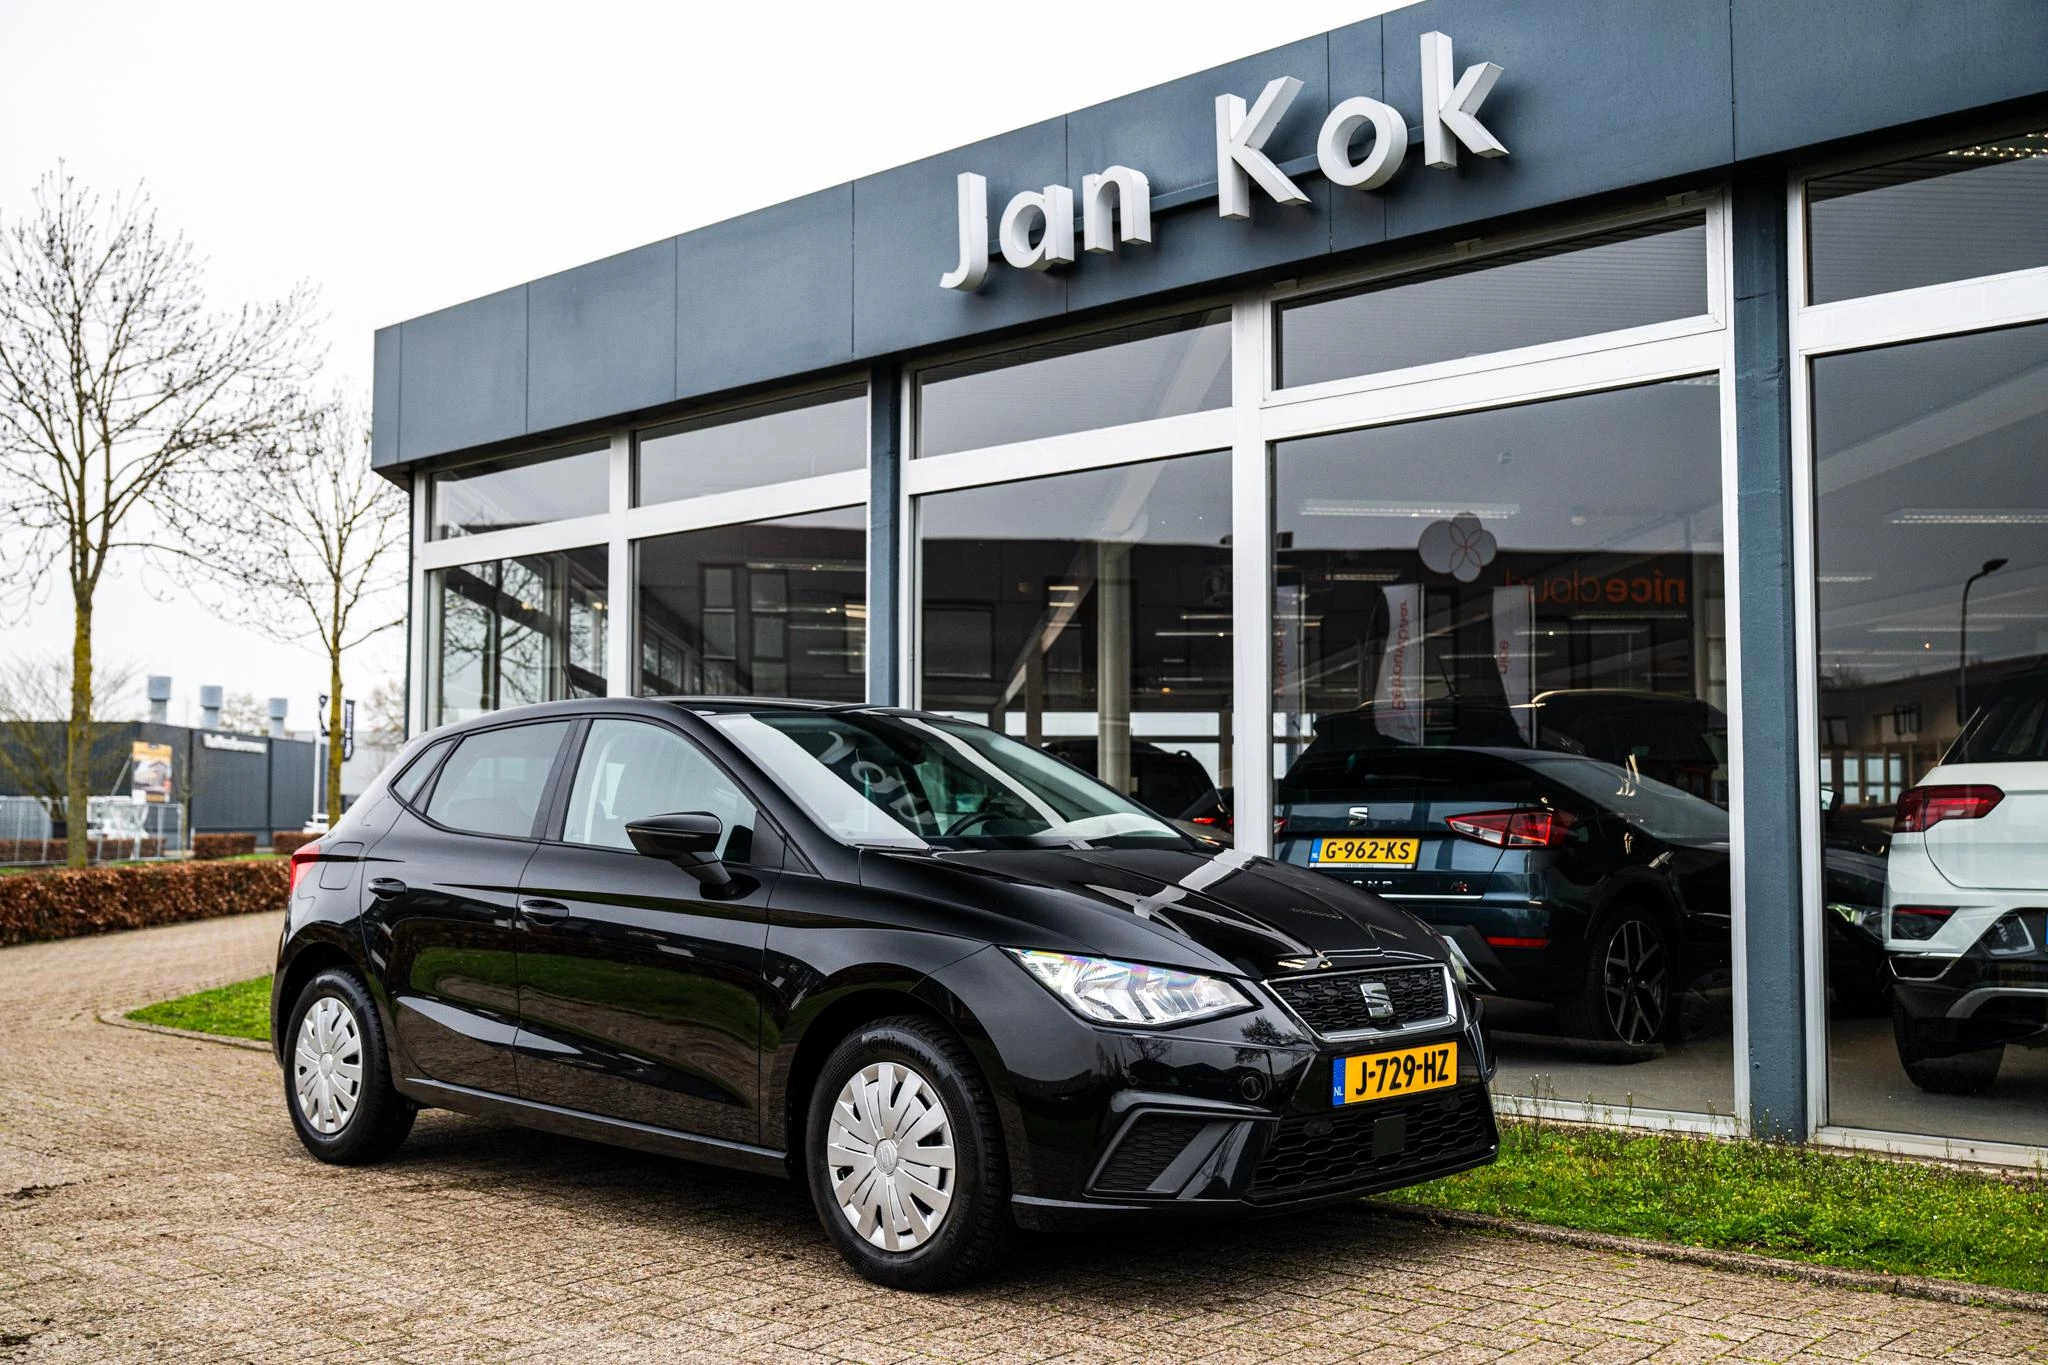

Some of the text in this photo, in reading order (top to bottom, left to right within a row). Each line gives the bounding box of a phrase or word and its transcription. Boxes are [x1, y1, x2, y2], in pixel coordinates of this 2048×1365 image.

[940, 31, 1510, 291] Jan Kok
[1325, 841, 1411, 860] G-962-KS
[1355, 1049, 1450, 1096] J-729-HZ
[1333, 1086, 1344, 1097] NL
